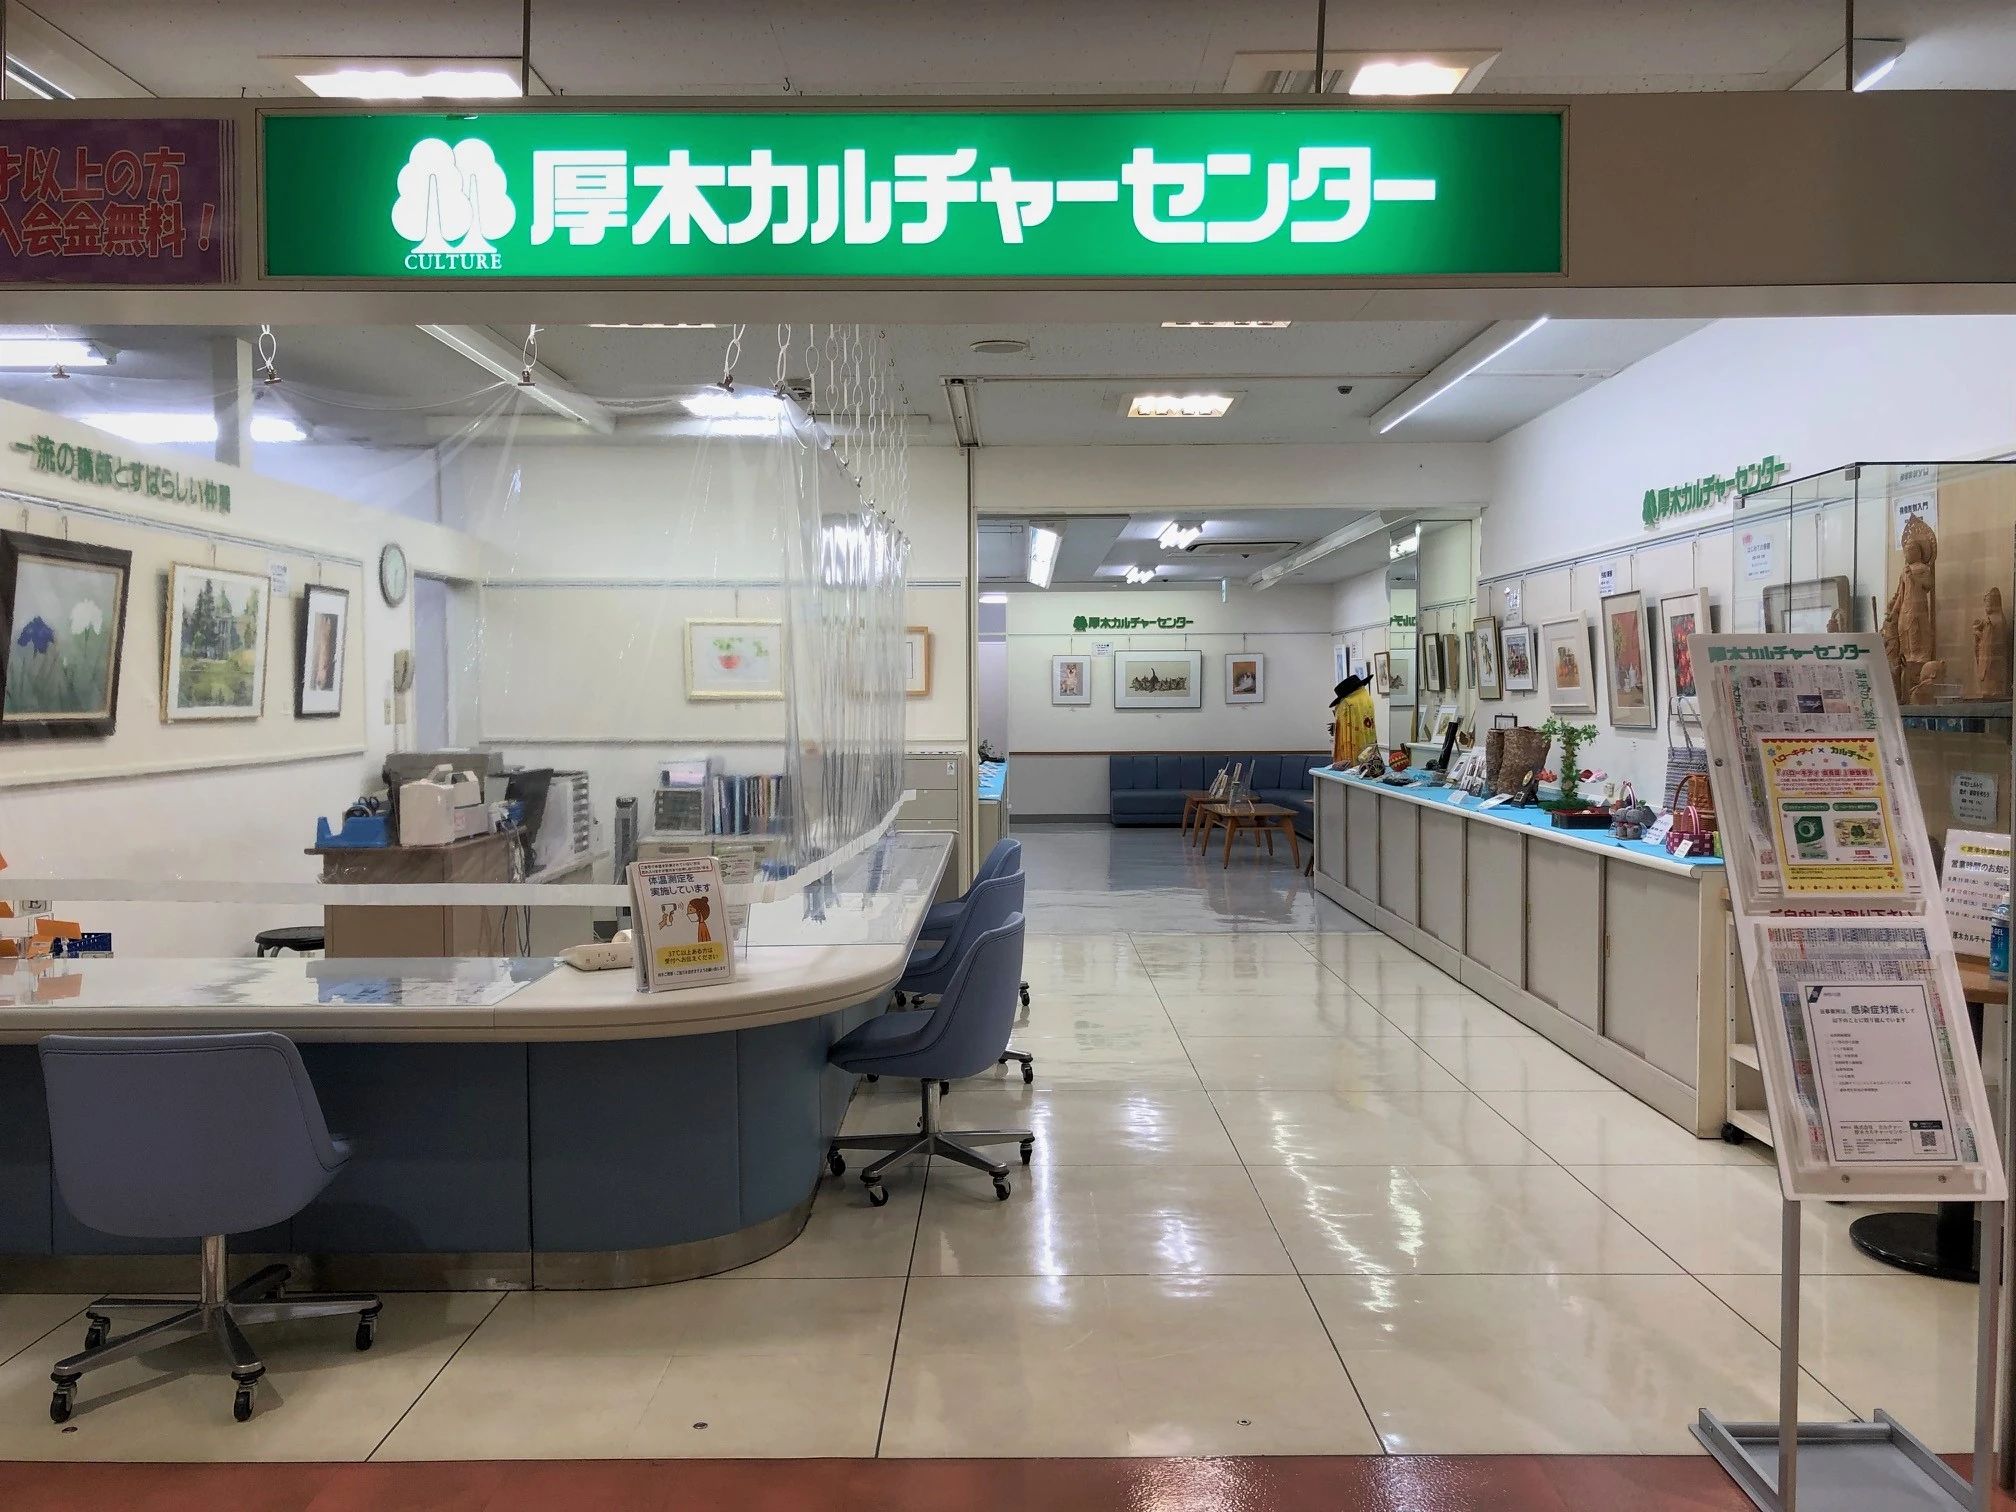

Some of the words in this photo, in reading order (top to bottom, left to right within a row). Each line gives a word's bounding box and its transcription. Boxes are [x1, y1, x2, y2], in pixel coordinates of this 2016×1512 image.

[531, 148, 1436, 245] 厚木カルチャーセンター
[404, 253, 502, 270] CULTURE
[1657, 455, 1786, 519] 厚木カルチャーセンター
[1088, 616, 1194, 630] 厚木カルチャーセンター
[1708, 644, 1871, 663] 厚木カルチャーセンター
[1772, 747, 1814, 766] ハローキティ
[1830, 746, 1871, 761] カルチャー
[648, 873, 695, 886] 体温測定を
[650, 883, 711, 897] 実施しています
